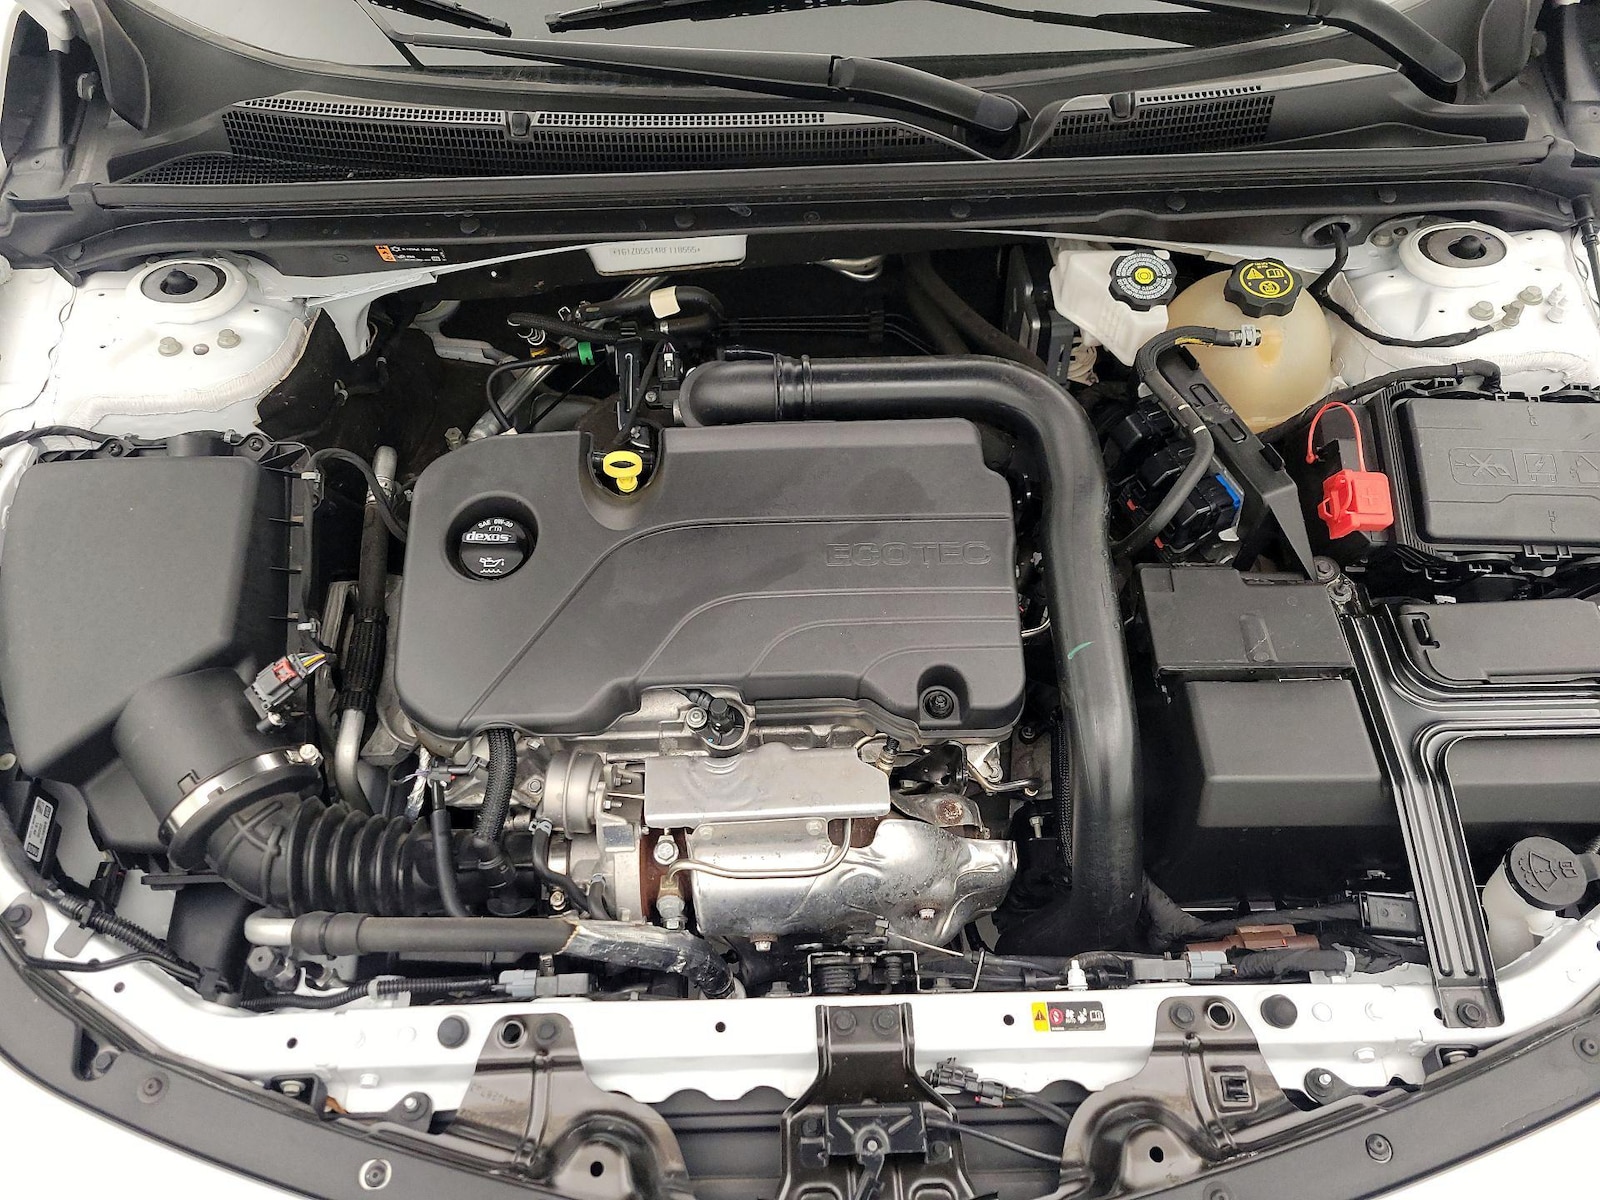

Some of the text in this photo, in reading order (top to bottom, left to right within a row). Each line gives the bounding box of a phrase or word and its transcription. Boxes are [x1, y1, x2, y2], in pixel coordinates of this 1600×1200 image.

[478, 518, 514, 528] SAE 0W-20
[466, 531, 512, 542] dexos
[826, 541, 992, 567] ECOTEC
